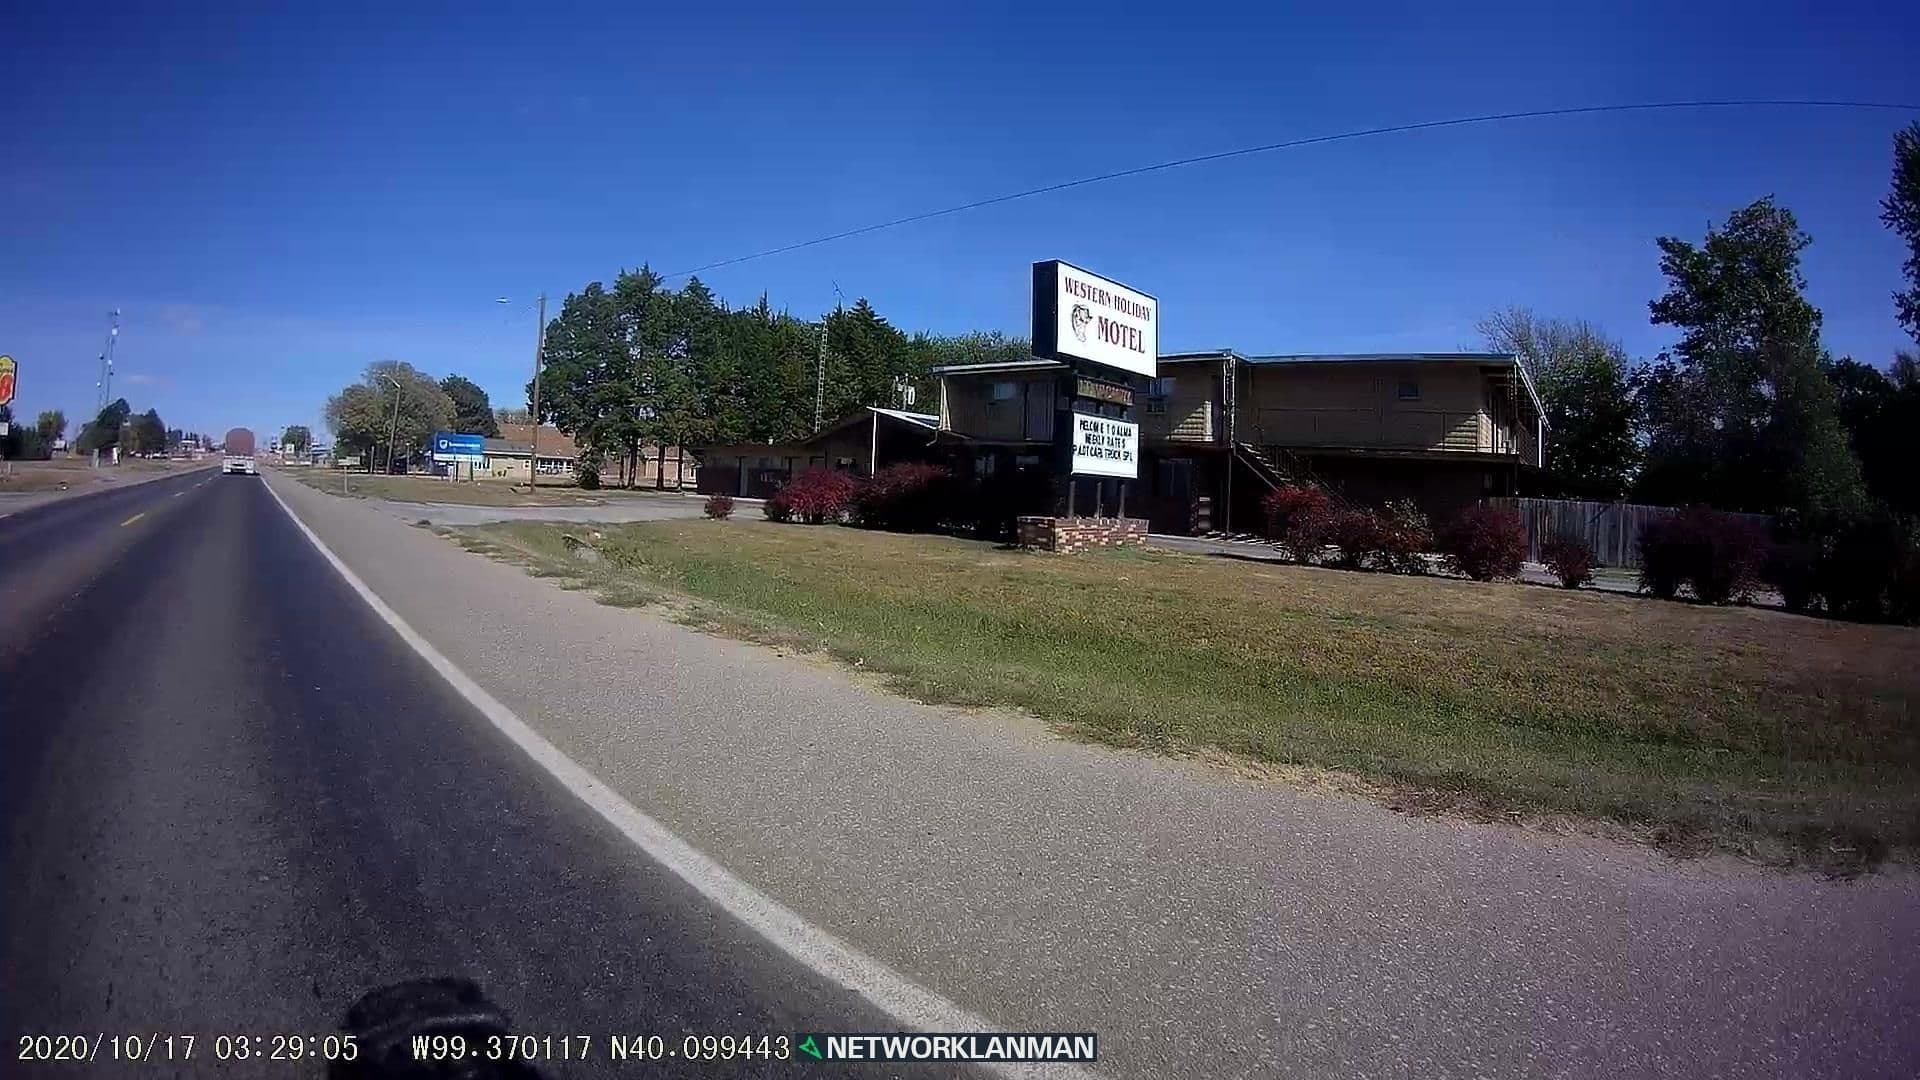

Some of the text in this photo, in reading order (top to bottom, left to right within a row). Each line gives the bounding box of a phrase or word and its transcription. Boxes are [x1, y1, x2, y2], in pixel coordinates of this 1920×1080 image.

[1065, 276, 1151, 321] WESTERN HOLIDAY
[1098, 315, 1145, 354] MOTEL
